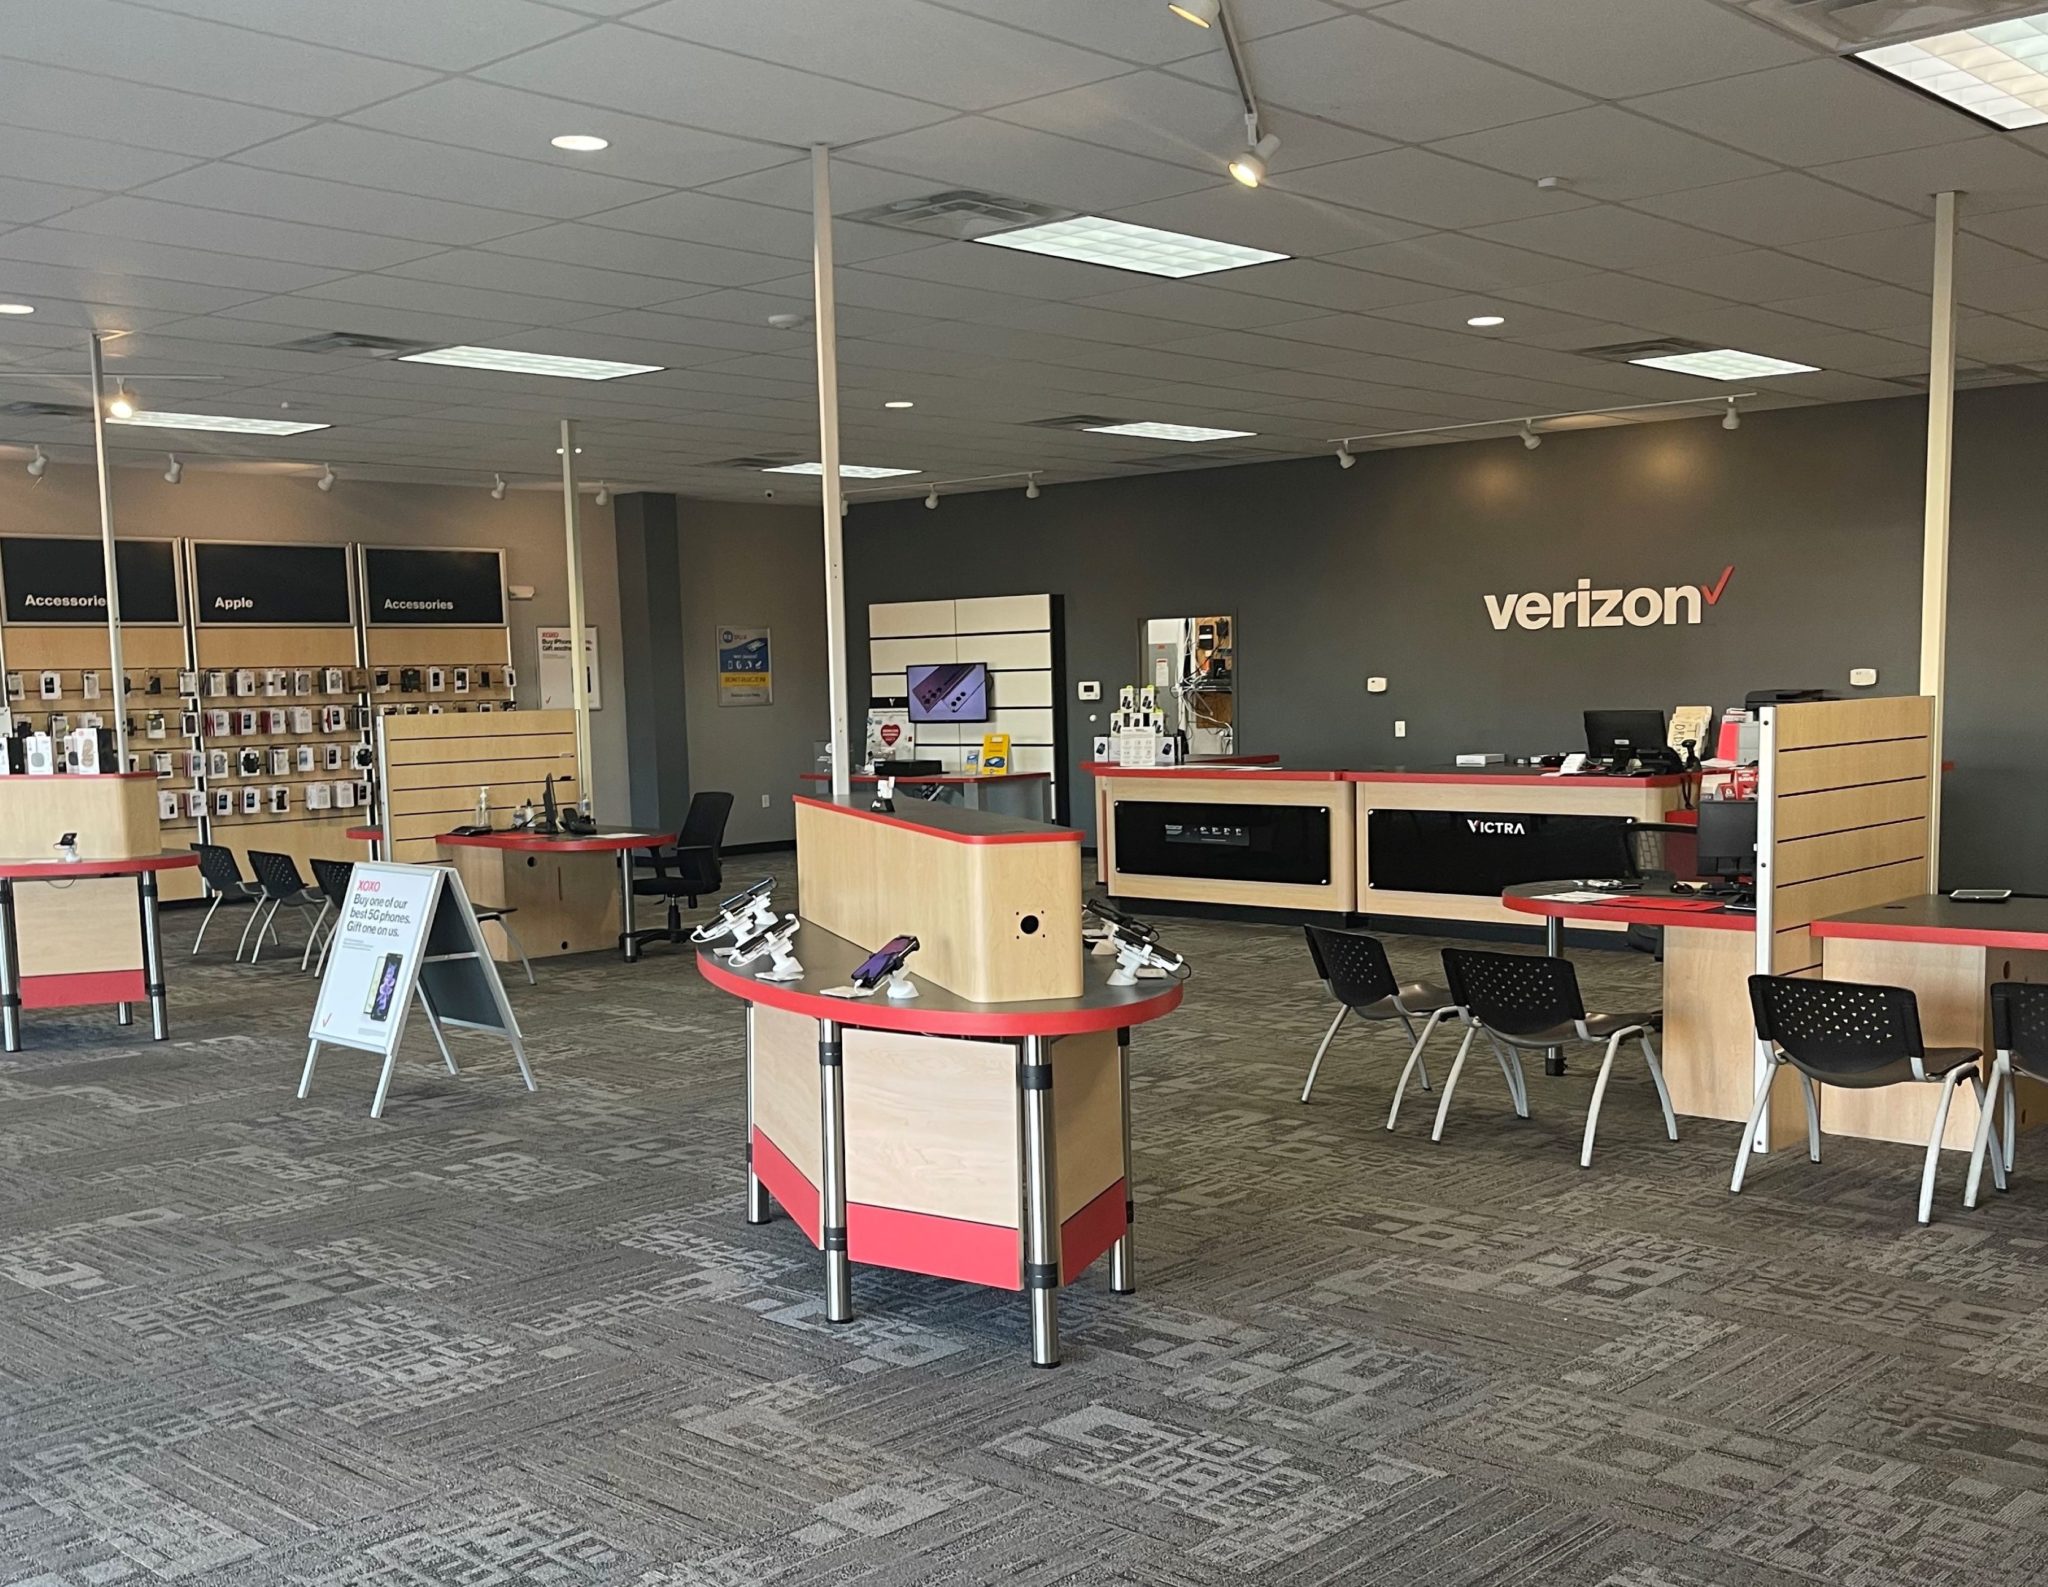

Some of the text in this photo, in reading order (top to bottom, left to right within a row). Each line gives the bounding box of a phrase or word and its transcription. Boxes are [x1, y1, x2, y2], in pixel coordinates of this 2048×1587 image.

[25, 594, 107, 607] Accessorie
[214, 596, 254, 611] Apple
[384, 598, 454, 610] Accessories
[1483, 578, 1702, 630] verizon
[1466, 818, 1526, 835] VICTRA
[357, 880, 381, 893] XOXO
[353, 893, 408, 909] Buy one of our
[349, 907, 411, 924] best 5G phones.
[346, 920, 400, 937] Gift one on us.
